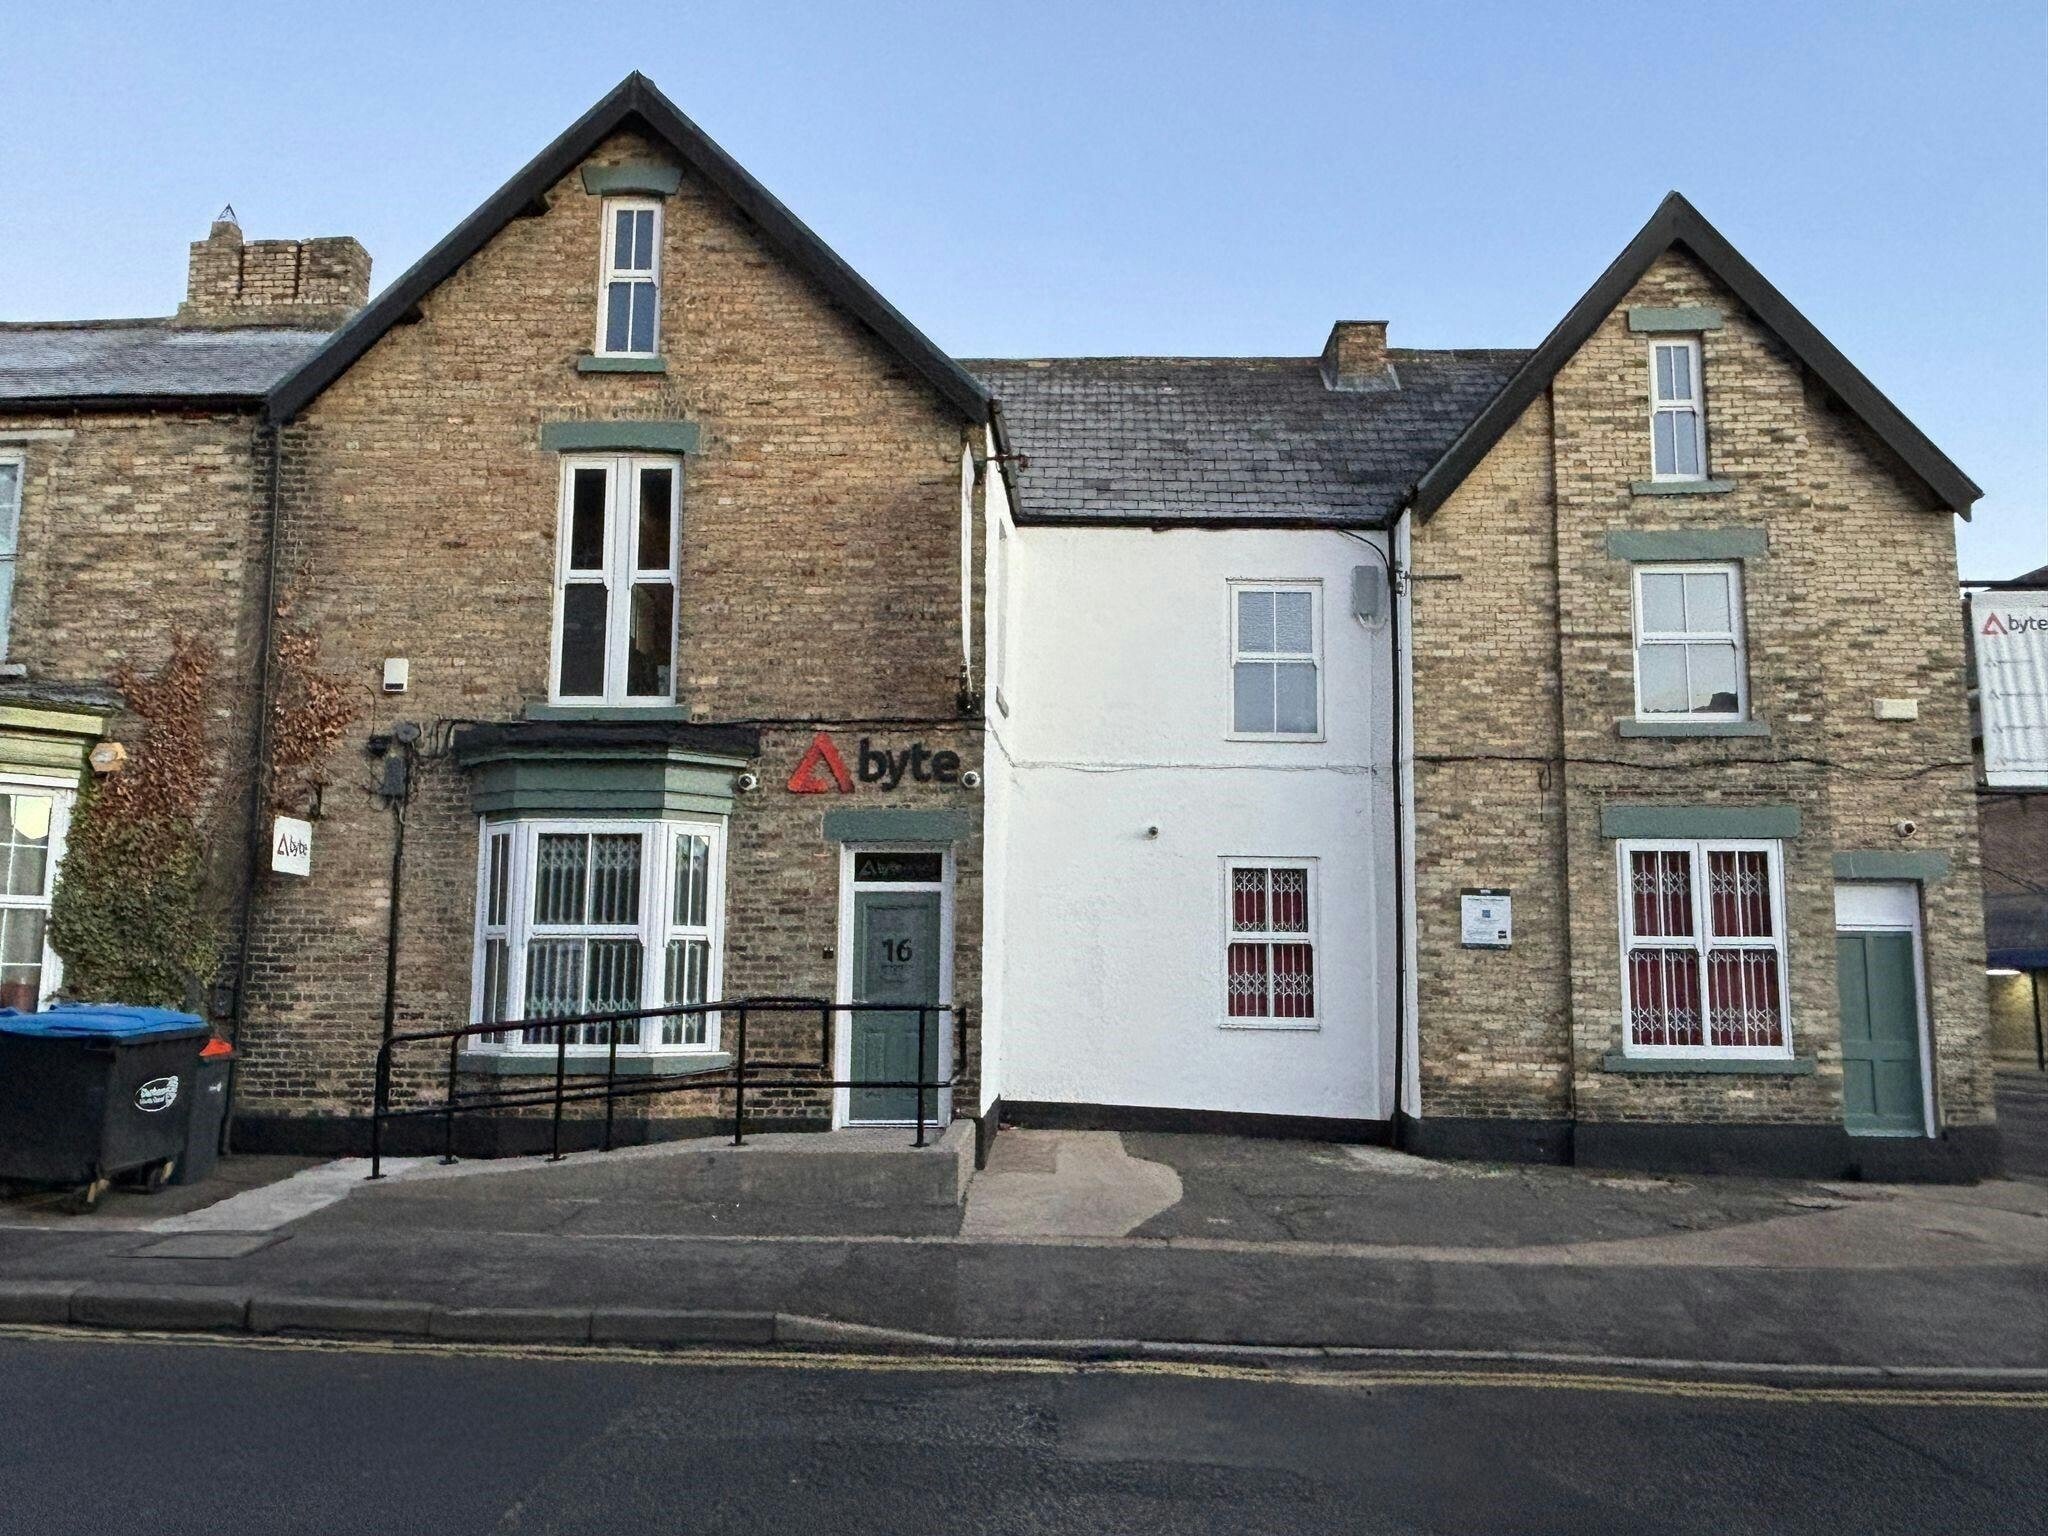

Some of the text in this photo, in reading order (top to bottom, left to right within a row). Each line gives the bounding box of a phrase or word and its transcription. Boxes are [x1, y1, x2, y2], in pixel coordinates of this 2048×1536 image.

[2008, 614, 2048, 633] byte
[859, 737, 960, 792] byte
[882, 938, 913, 962] 16
